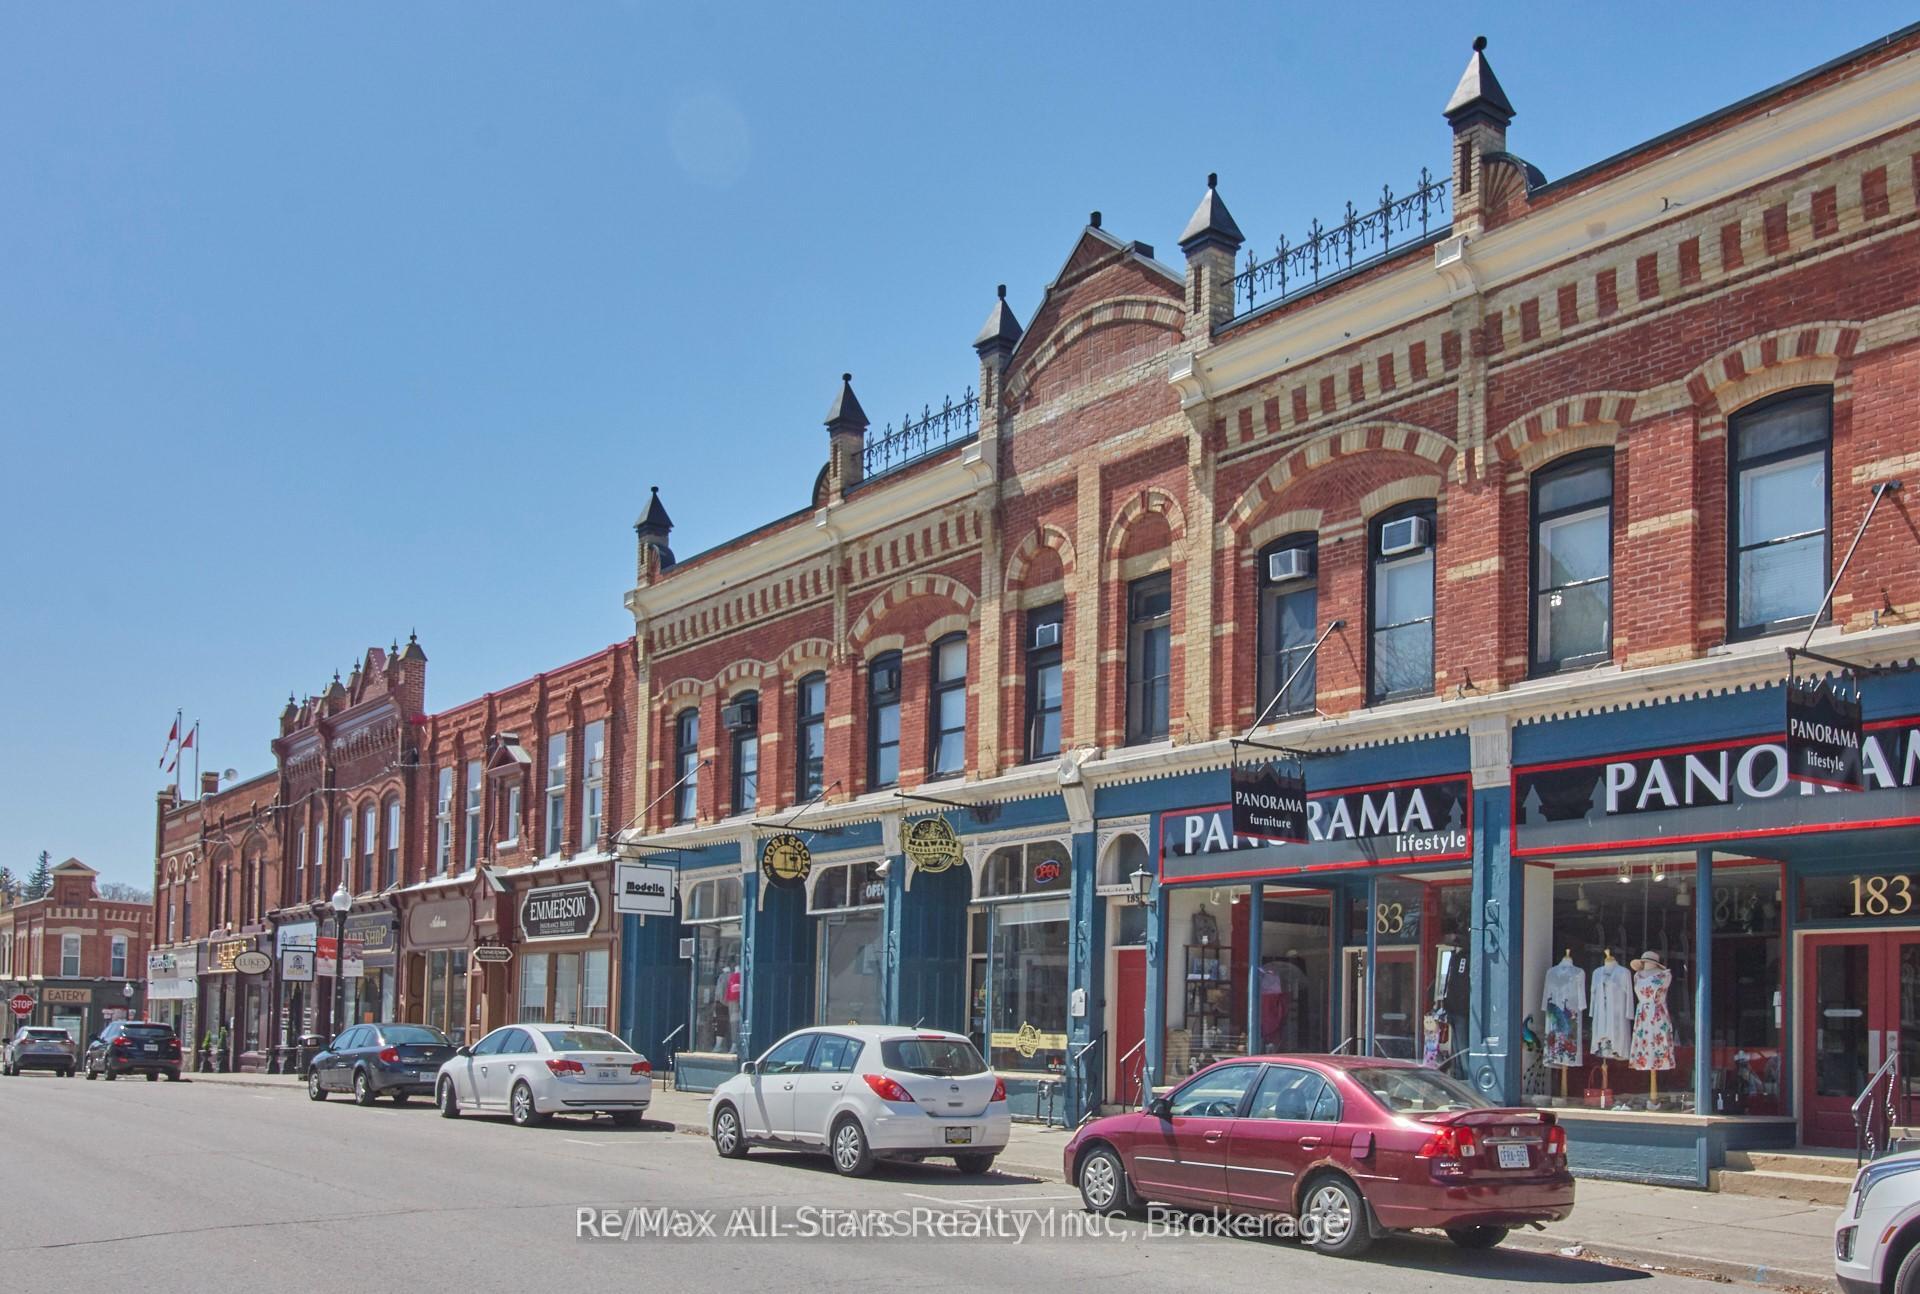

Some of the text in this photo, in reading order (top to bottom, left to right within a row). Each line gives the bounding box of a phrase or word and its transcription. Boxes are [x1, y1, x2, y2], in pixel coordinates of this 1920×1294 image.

[1790, 718, 1859, 749] PANORAMA
[1807, 750, 1844, 773] lifestyle
[1235, 791, 1303, 813] PANORAMA
[1184, 788, 1434, 855] PARAMA
[1249, 813, 1292, 830] furniture
[764, 836, 786, 864] PORT
[1395, 830, 1466, 854] lifestyle
[1034, 864, 1060, 879] OPEN
[1849, 874, 1913, 916] 183
[530, 896, 587, 921] EMMERSON
[1376, 902, 1404, 934] 83
[12, 1000, 33, 1010] STOP
[48, 990, 86, 1001] EATERY
